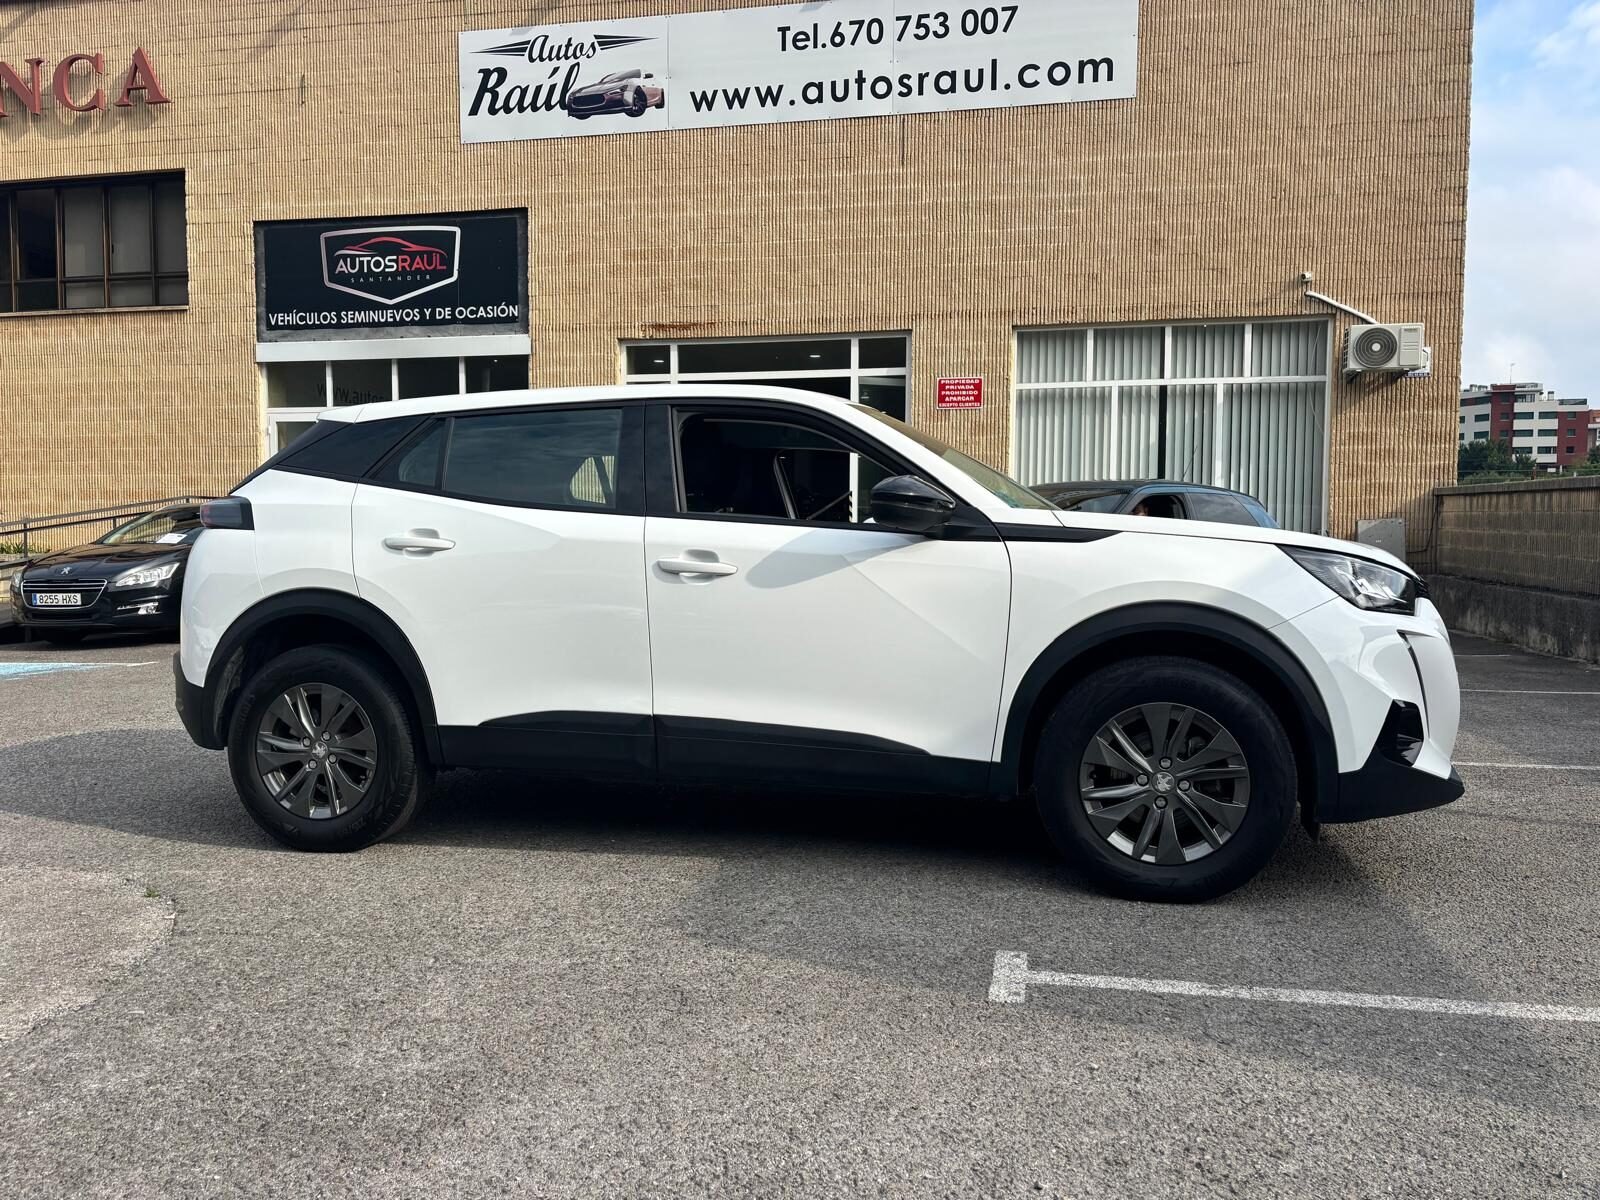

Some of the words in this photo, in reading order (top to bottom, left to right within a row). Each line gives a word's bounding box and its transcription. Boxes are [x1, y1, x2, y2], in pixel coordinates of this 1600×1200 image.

[777, 17, 884, 52] Tel.670
[895, 11, 950, 42] 753
[960, 5, 1019, 36] 007
[527, 34, 598, 63] Autos
[0, 46, 172, 117] NCA
[467, 61, 580, 117] Raúl
[689, 55, 1114, 113] www.autosraul.com
[351, 275, 430, 283] SANTANDER
[268, 309, 338, 326] VEHÍCULOS
[340, 307, 421, 324] SEMINUEVOS
[424, 308, 432, 320] Y
[435, 307, 453, 319] DE
[455, 301, 519, 319] OCASIÓN
[38, 594, 60, 604] 8255
[61, 594, 78, 604] HXS
